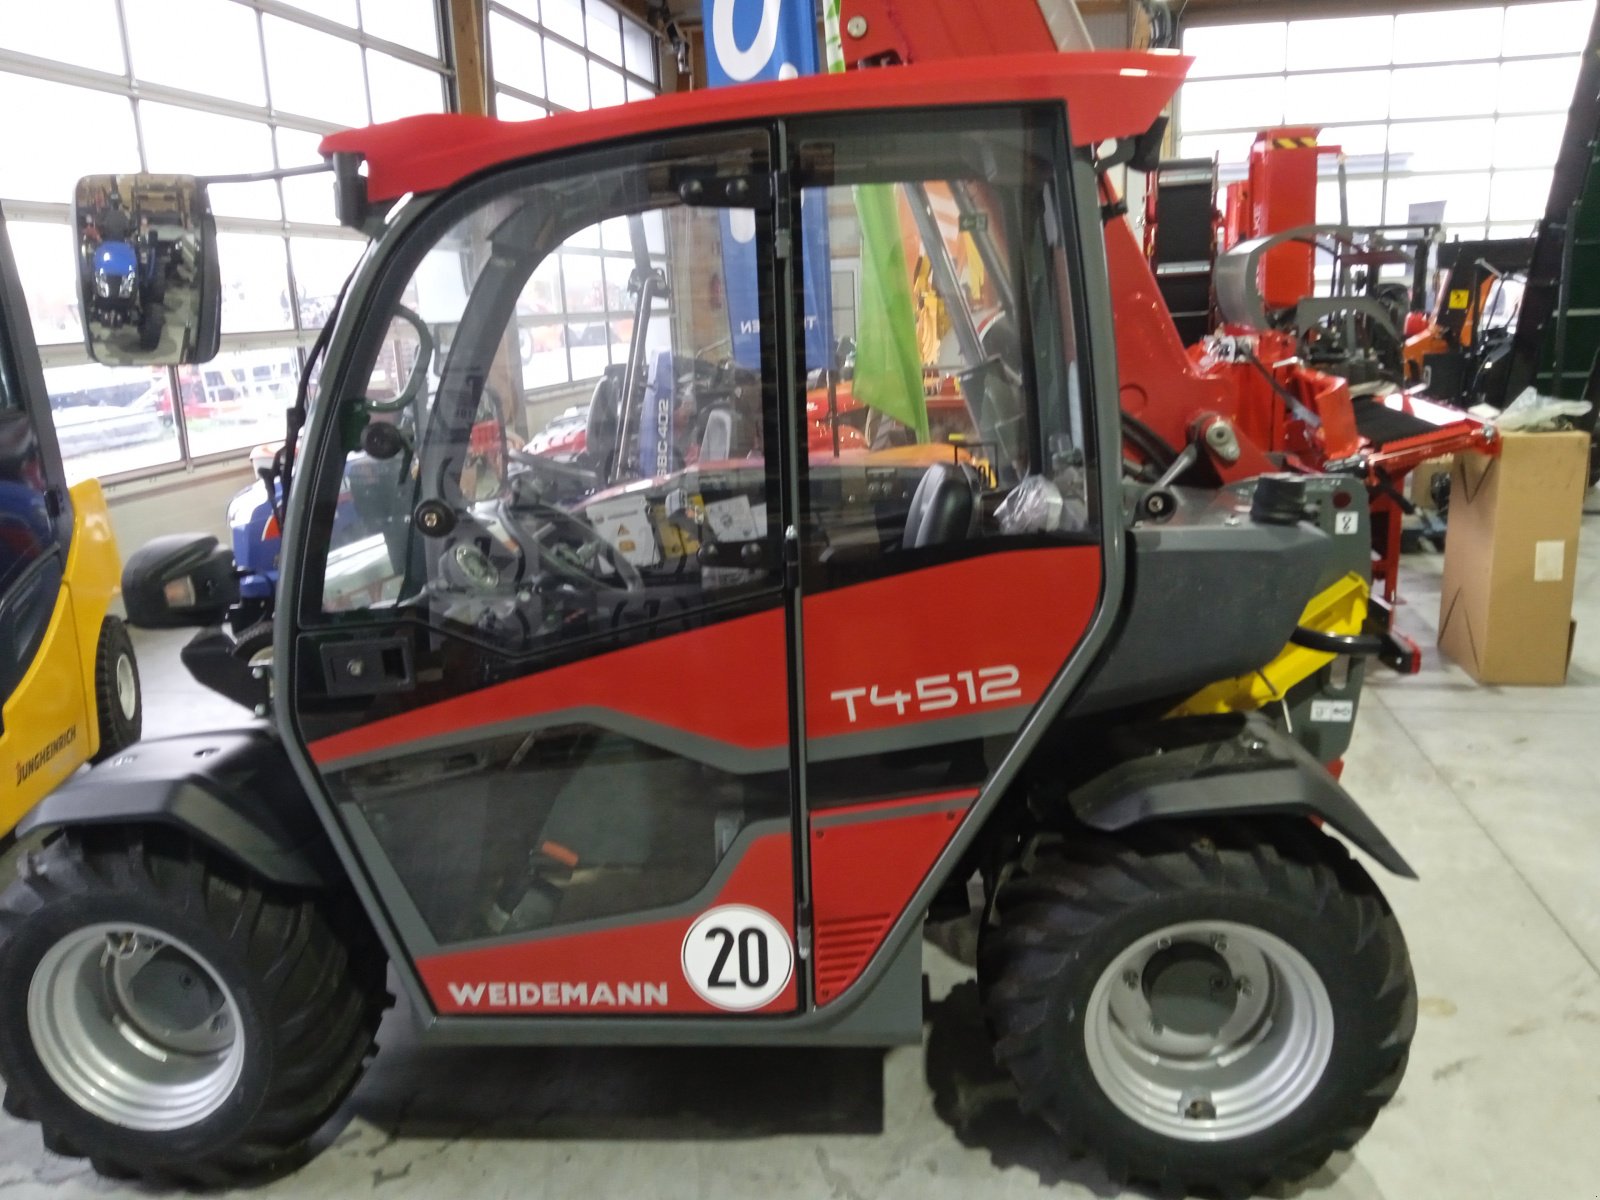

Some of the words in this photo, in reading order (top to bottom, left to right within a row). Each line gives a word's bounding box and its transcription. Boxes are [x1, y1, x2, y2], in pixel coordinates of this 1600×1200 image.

[657, 399, 669, 438] 402
[830, 664, 1022, 723] T4512
[16, 724, 77, 787] JUNGHEINRICH
[705, 926, 769, 990] 20
[448, 982, 669, 1007] WEIDEMANN
